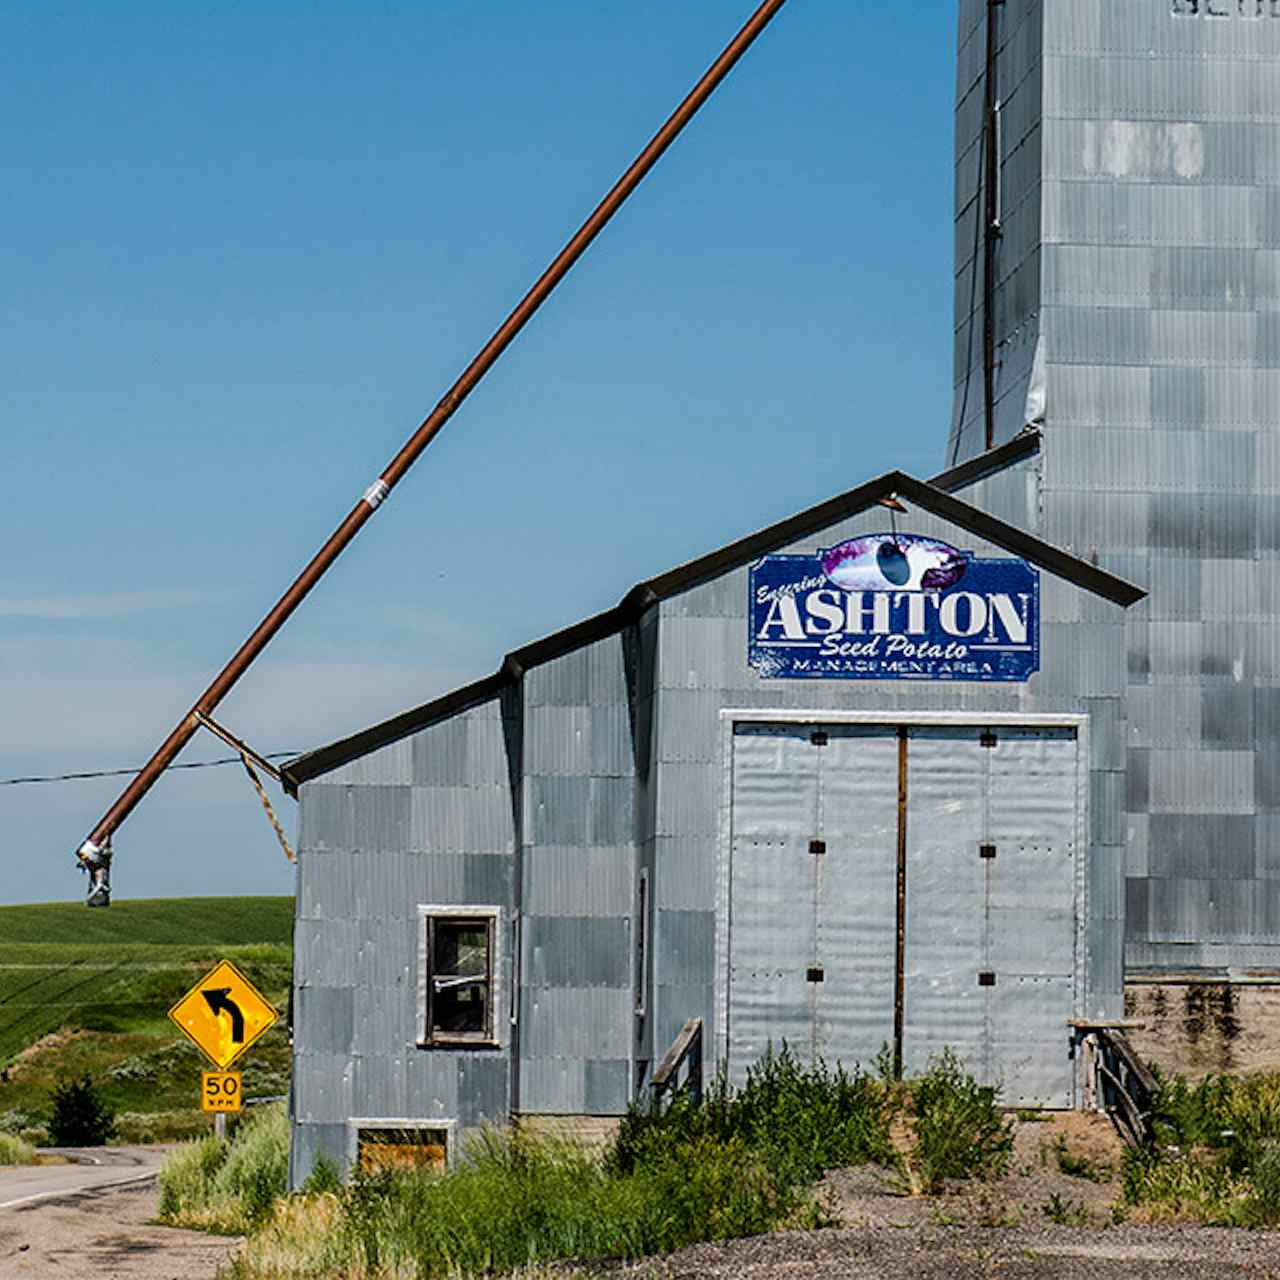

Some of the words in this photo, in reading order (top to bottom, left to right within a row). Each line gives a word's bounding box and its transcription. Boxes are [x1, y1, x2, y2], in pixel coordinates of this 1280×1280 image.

[756, 574, 828, 604] Entering
[756, 588, 1032, 644] ASHTON
[818, 633, 880, 658] Seed
[885, 634, 969, 660] Potato
[792, 658, 935, 674] MANAGEMENT
[938, 660, 993, 675] AREA
[206, 1077, 238, 1096] 50
